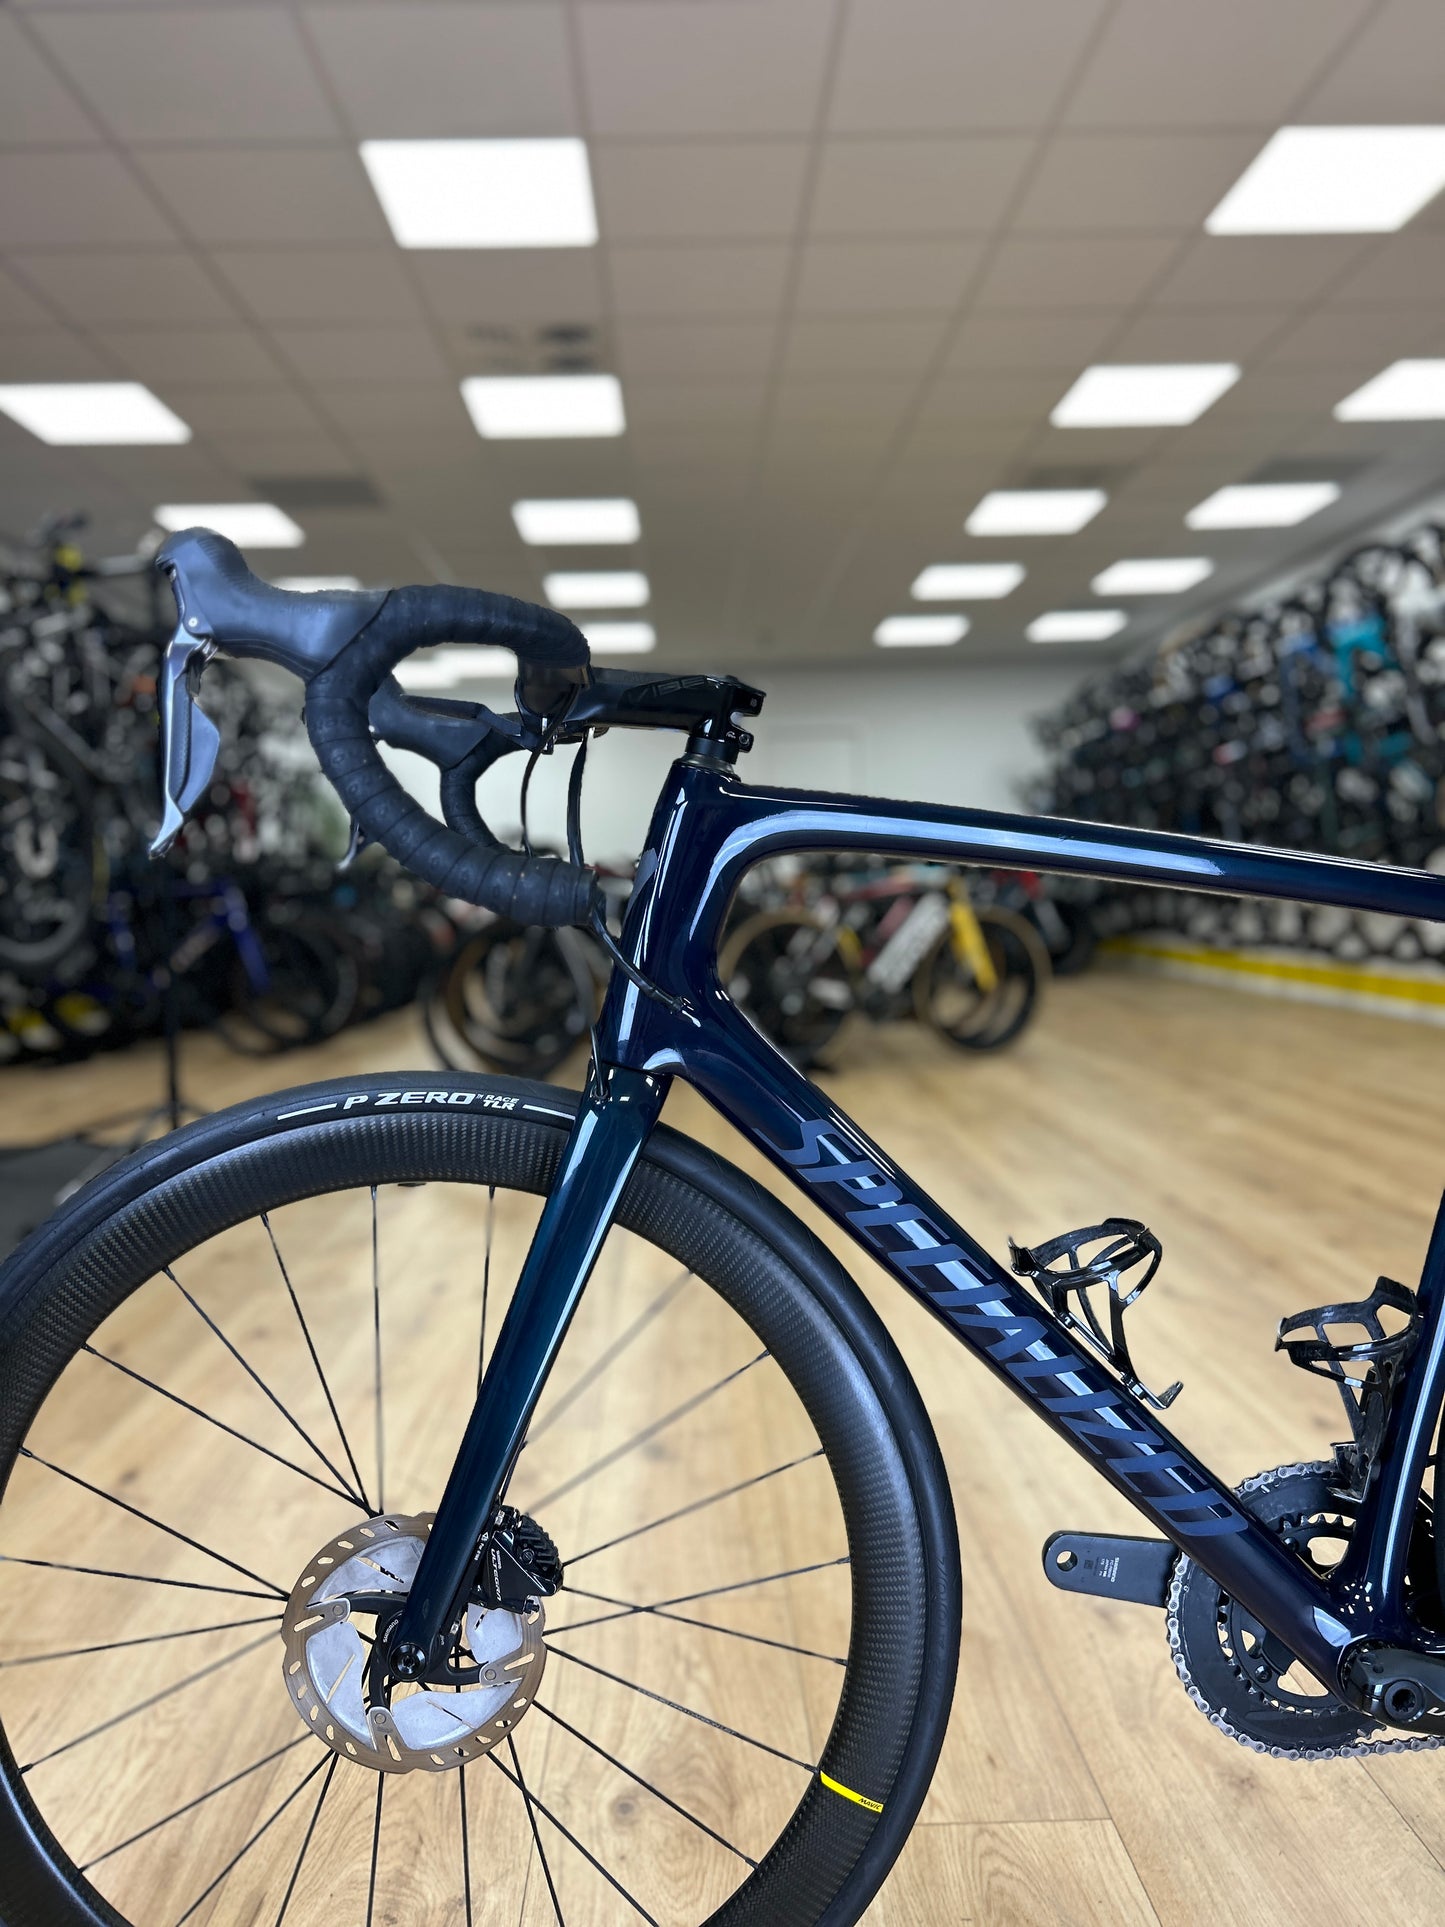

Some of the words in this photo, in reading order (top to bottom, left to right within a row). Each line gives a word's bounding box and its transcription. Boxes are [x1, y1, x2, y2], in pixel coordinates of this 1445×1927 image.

[627, 675, 706, 703] VIBE
[343, 1094, 369, 1109] P
[483, 1099, 516, 1111] TLR
[485, 1094, 520, 1104] RACE
[751, 1118, 1249, 1536] SPECIALIZED
[490, 1548, 502, 1602] ULTEGRA
[382, 1619, 399, 1643] SHIMANO
[858, 1798, 882, 1809] MAVIC
